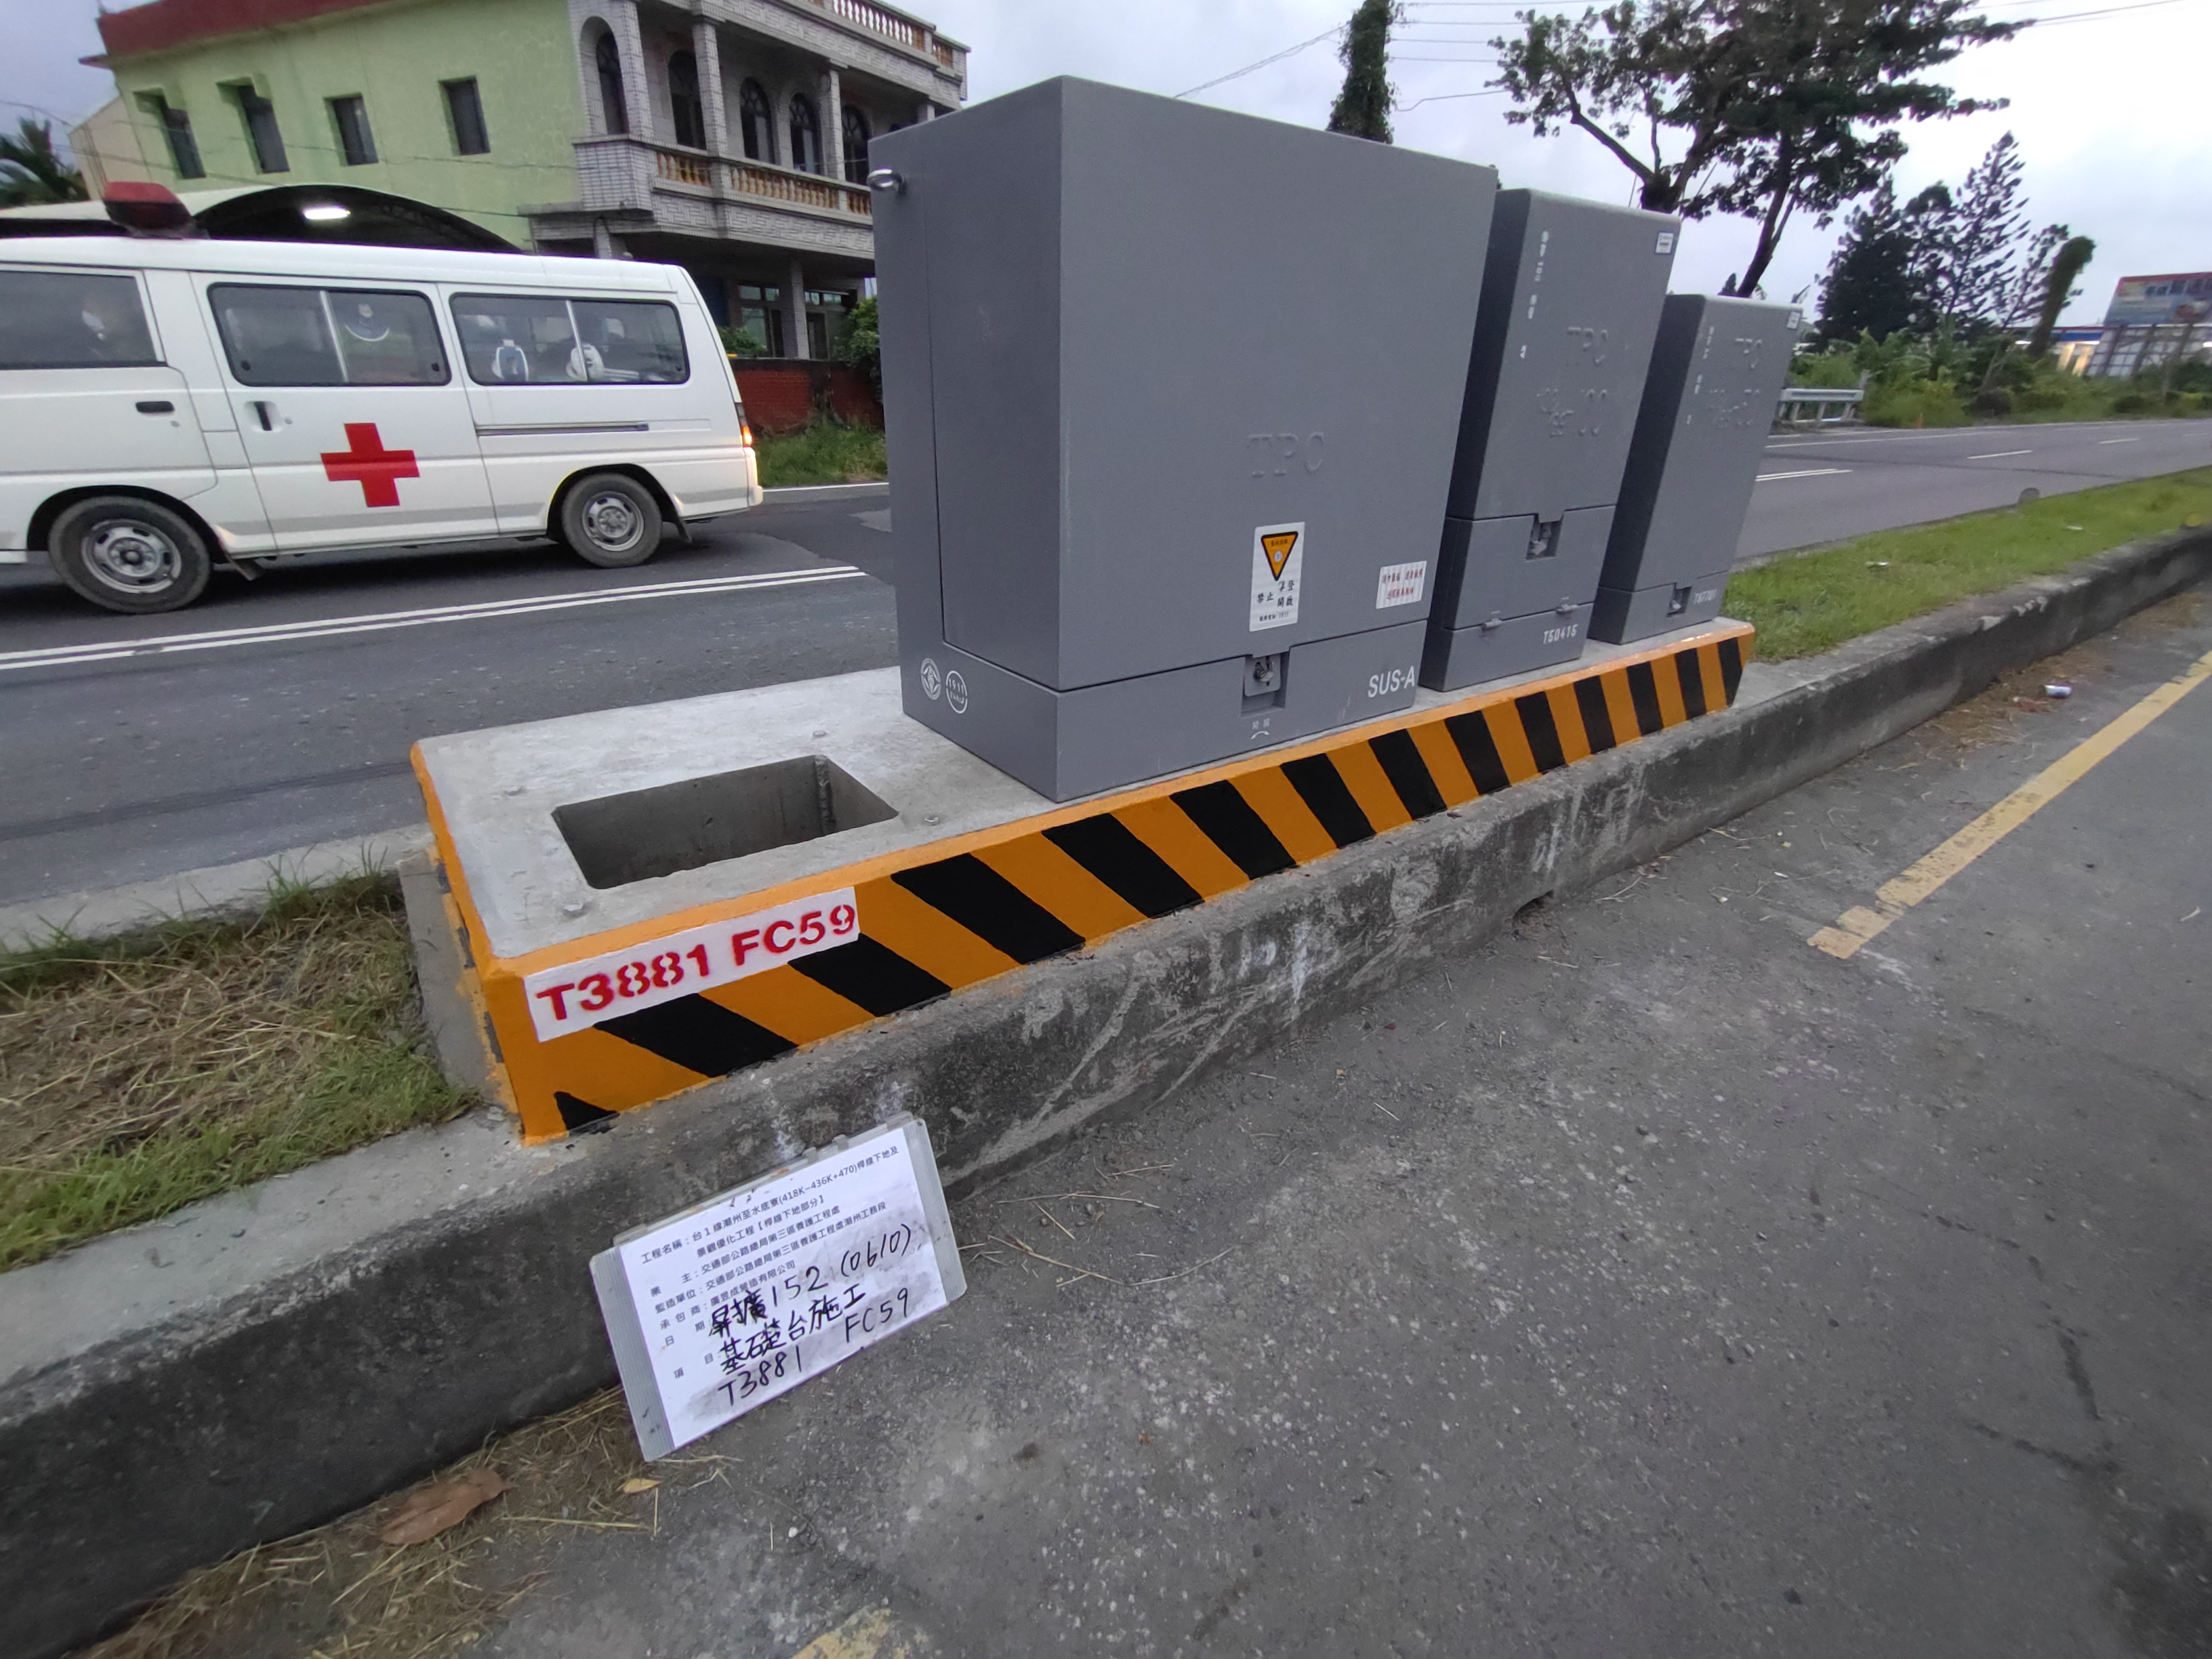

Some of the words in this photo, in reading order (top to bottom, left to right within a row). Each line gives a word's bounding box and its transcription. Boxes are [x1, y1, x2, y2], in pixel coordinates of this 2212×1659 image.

[1368, 665, 1416, 698] SUS-A
[536, 944, 710, 1021] T3881
[731, 904, 856, 966] FC59
[718, 1345, 802, 1406] T3881
[845, 1287, 907, 1343] FC59
